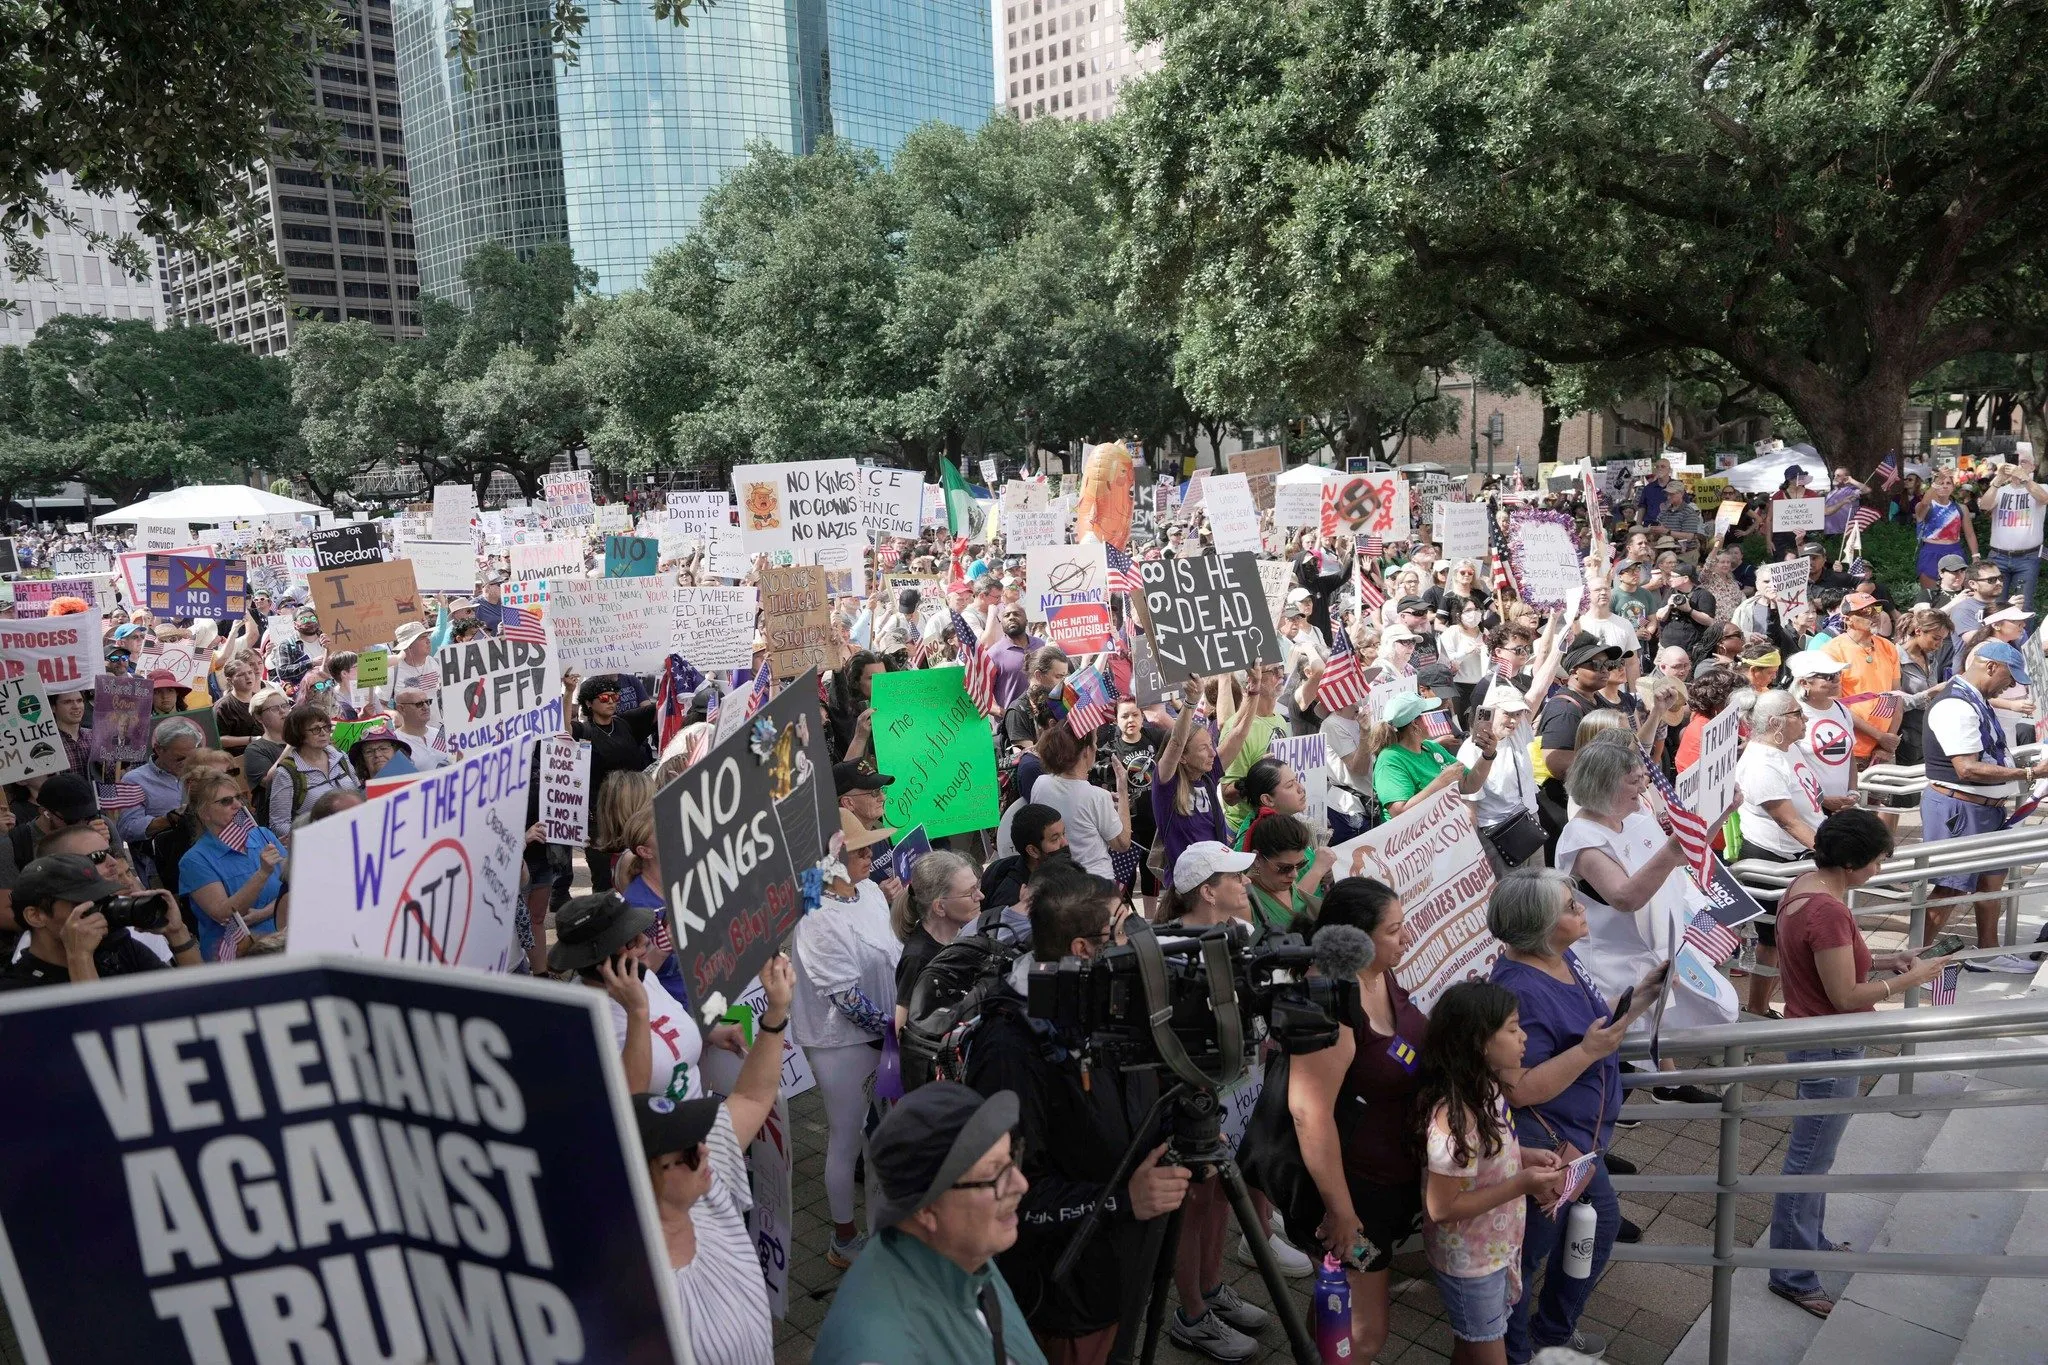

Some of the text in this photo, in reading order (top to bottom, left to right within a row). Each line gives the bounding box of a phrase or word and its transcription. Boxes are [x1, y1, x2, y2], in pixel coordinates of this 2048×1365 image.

[543, 470, 588, 484] THIS IS THE
[786, 470, 856, 494] NO KINGS
[545, 481, 589, 497] GOVERNMENT
[868, 487, 880, 497] IS
[1423, 482, 1466, 494] WHEN TYRANNY
[1698, 485, 1720, 493] DUMP
[667, 493, 724, 506] Grow up
[789, 496, 857, 520] NO CLOWNS
[2000, 492, 2030, 509] WE THE
[669, 508, 719, 520] Donnie
[147, 525, 176, 535] IMPEACH
[311, 526, 362, 541] STAND FOR
[792, 521, 857, 542] NO NAZIS
[147, 540, 174, 549] CONVICT
[613, 538, 646, 562] NO
[75, 562, 95, 570] NOT
[251, 555, 263, 569] NO
[292, 555, 312, 568] NO
[1771, 560, 1808, 575] NO THRONES
[760, 571, 780, 593] NO
[1171, 559, 1196, 594] IS
[1204, 553, 1241, 591] HE
[1772, 568, 1808, 583] NO CROWNS
[51, 582, 93, 591] PARALYZE
[504, 582, 527, 594] NOT
[552, 581, 563, 593] I
[596, 579, 635, 590] BELIEVE
[891, 579, 921, 587] REMEMBER
[1785, 576, 1806, 590] KINGS
[16, 591, 95, 602] UR THE
[187, 590, 211, 604] NO
[504, 593, 550, 605] PRESIDEN
[555, 590, 670, 609] MAD WE'RE TAKING YOUR
[700, 589, 744, 602] WHERE
[769, 591, 822, 614] ILLEGAL
[1067, 587, 1102, 604] KINGS
[176, 604, 222, 618] KINGS
[552, 605, 668, 628] YOU'RE MAD THAT WE'RE
[700, 604, 730, 615] THEY
[1175, 591, 1253, 635] DEAD
[590, 626, 619, 635] ACROSS
[623, 623, 648, 632] STAGES
[785, 614, 805, 629] ON
[1050, 614, 1099, 629] ONE NATION
[1, 629, 78, 649] PROCESS
[672, 632, 687, 641] OF
[773, 624, 827, 649] STOLEN
[1051, 622, 1110, 641] INDIVISIBLE
[563, 637, 600, 647] EARNING
[926, 640, 939, 658] NO
[1195, 625, 1264, 672] YET?
[144, 656, 200, 674] FASCISM
[440, 637, 546, 687] HANDS
[584, 658, 603, 670] FOR
[781, 648, 824, 671] LAND
[37, 655, 81, 684] ALL
[20, 720, 56, 743] LIKE
[888, 713, 914, 739] The
[554, 744, 573, 757] NO
[1122, 749, 1156, 766] EQUALITY
[1289, 733, 1326, 772] HUMAN
[549, 759, 575, 772] ROBE
[1707, 745, 1737, 791] TANK!
[555, 774, 571, 786] NO
[932, 760, 974, 813] though
[546, 789, 584, 806] CROWN
[555, 807, 570, 820] NO
[680, 756, 741, 857] NO
[351, 733, 533, 912] WE THE PEOPLE
[545, 820, 584, 843] TRONE
[1384, 816, 1430, 860] ALIANZA
[671, 809, 776, 950] KINGS
[1410, 887, 1457, 938] FAMILIES
[1443, 900, 1489, 950] REFOR
[72, 996, 527, 1142] VETERANS
[121, 1112, 555, 1278] AGAINST
[148, 1243, 586, 1365] TRUMP
